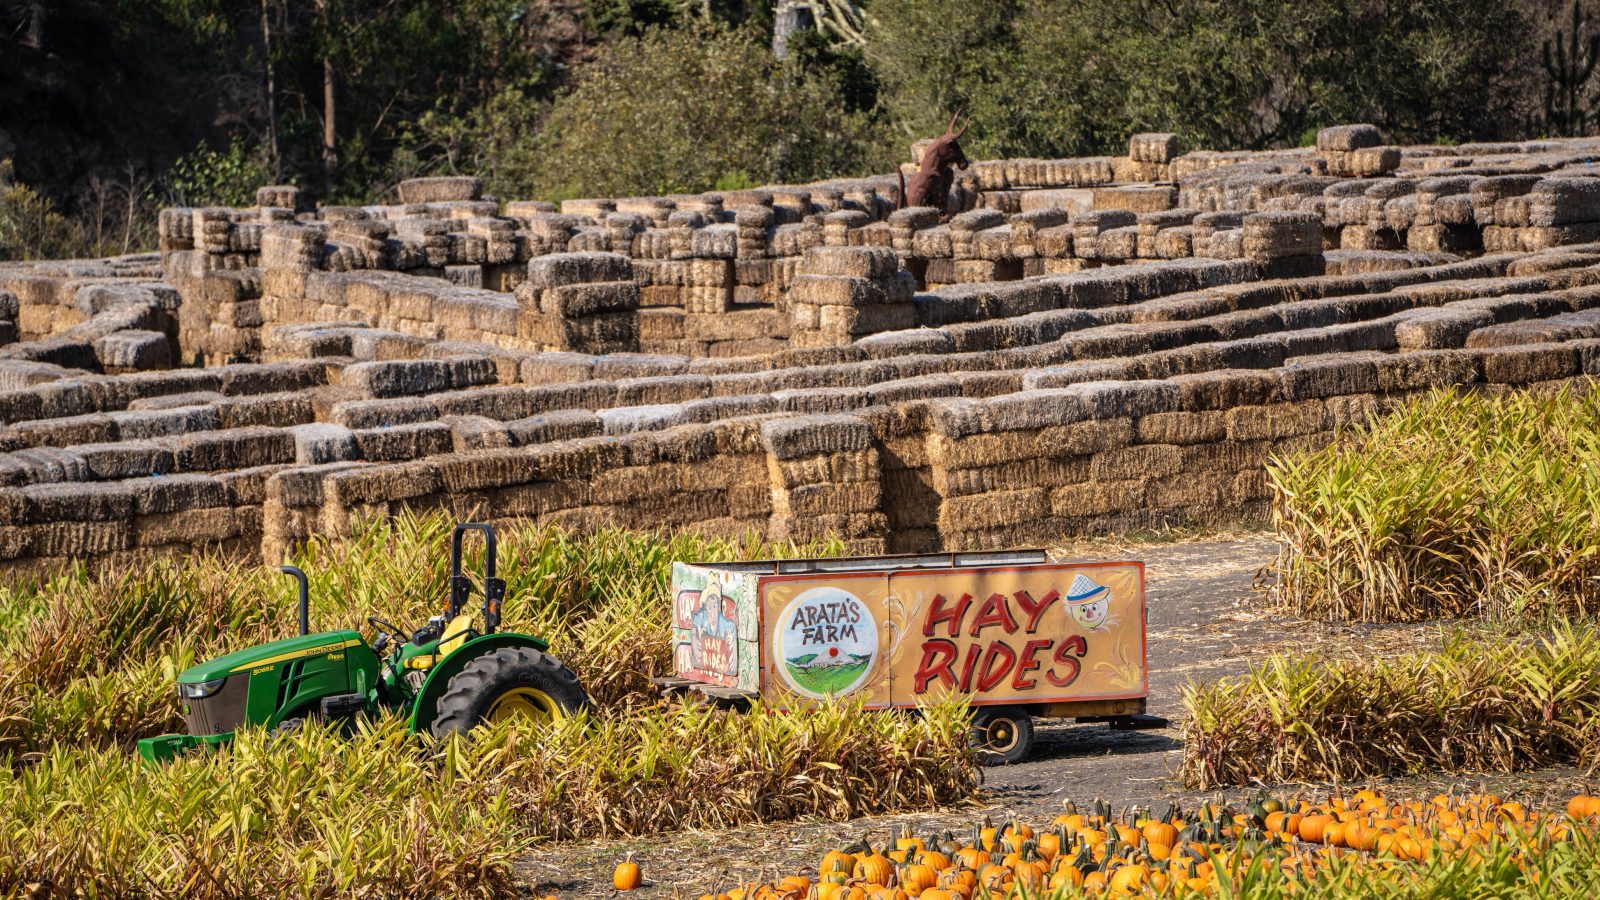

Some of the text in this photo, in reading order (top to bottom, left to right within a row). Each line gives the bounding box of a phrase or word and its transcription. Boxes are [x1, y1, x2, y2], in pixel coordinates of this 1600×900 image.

[791, 598, 862, 631] ARATA'S
[922, 590, 1061, 638] HAY
[704, 637, 721, 653] HAY
[802, 624, 858, 645] FARM
[678, 649, 694, 674] HA
[703, 651, 726, 670] RIDES
[914, 635, 1087, 695] RIDES
